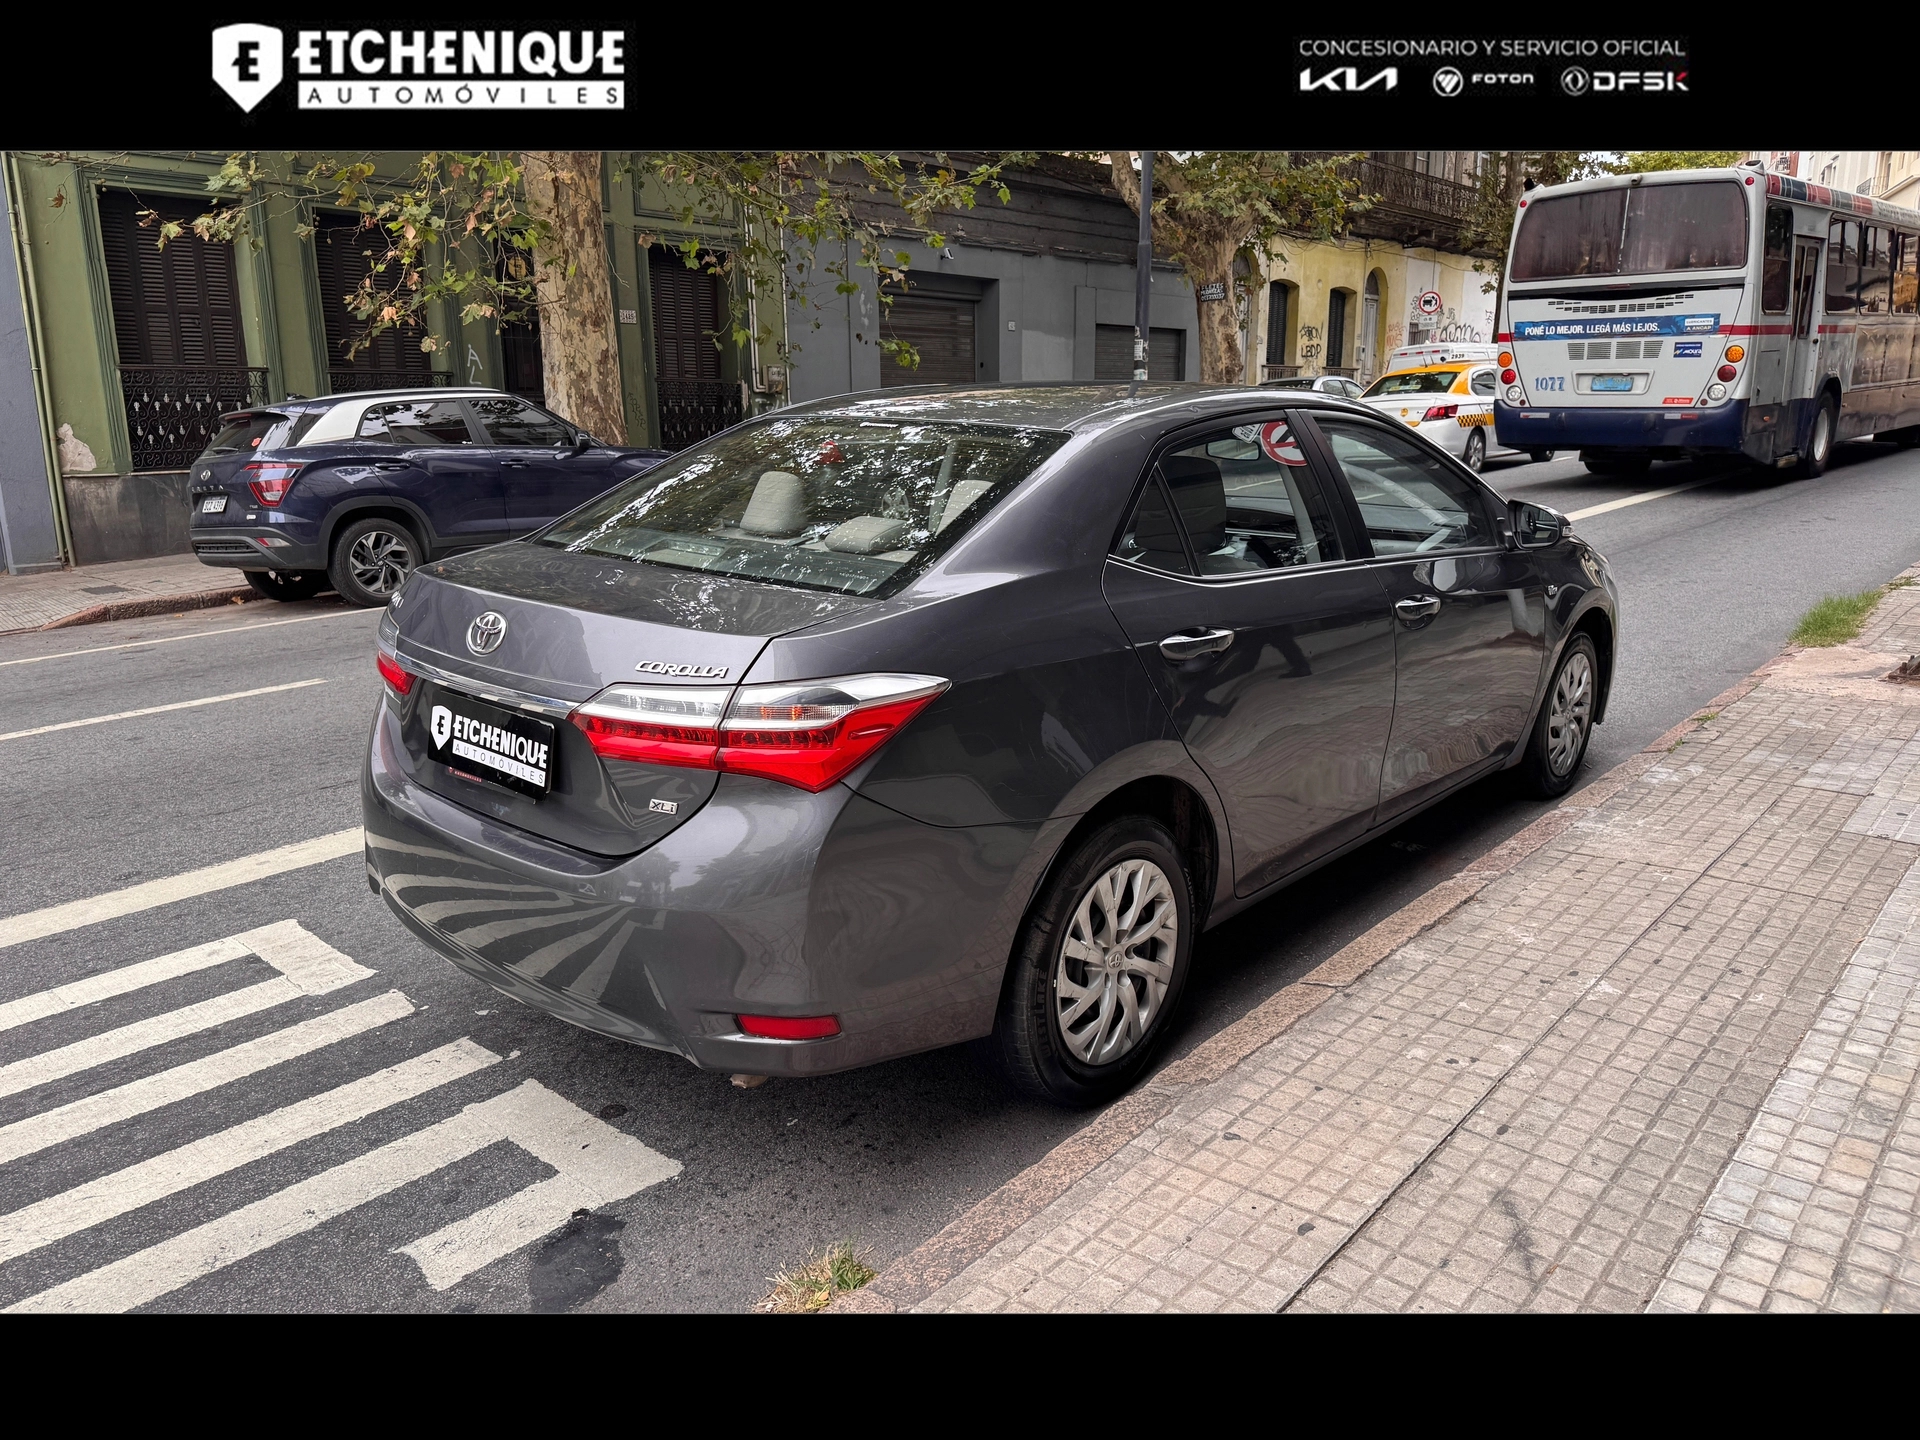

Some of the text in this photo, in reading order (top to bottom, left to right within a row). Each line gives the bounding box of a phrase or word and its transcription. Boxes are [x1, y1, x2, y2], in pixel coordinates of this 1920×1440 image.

[1525, 321, 1660, 336] PONÉ LO MEJOR. LLEGÁ MÁS LEJOS.
[1535, 376, 1565, 392] 1077
[634, 660, 730, 679] COROLLA
[452, 714, 549, 770] ETCHENIQUE
[454, 743, 545, 785] AUTOMÓVILES
[1034, 969, 1052, 1060] WESTLAKE
